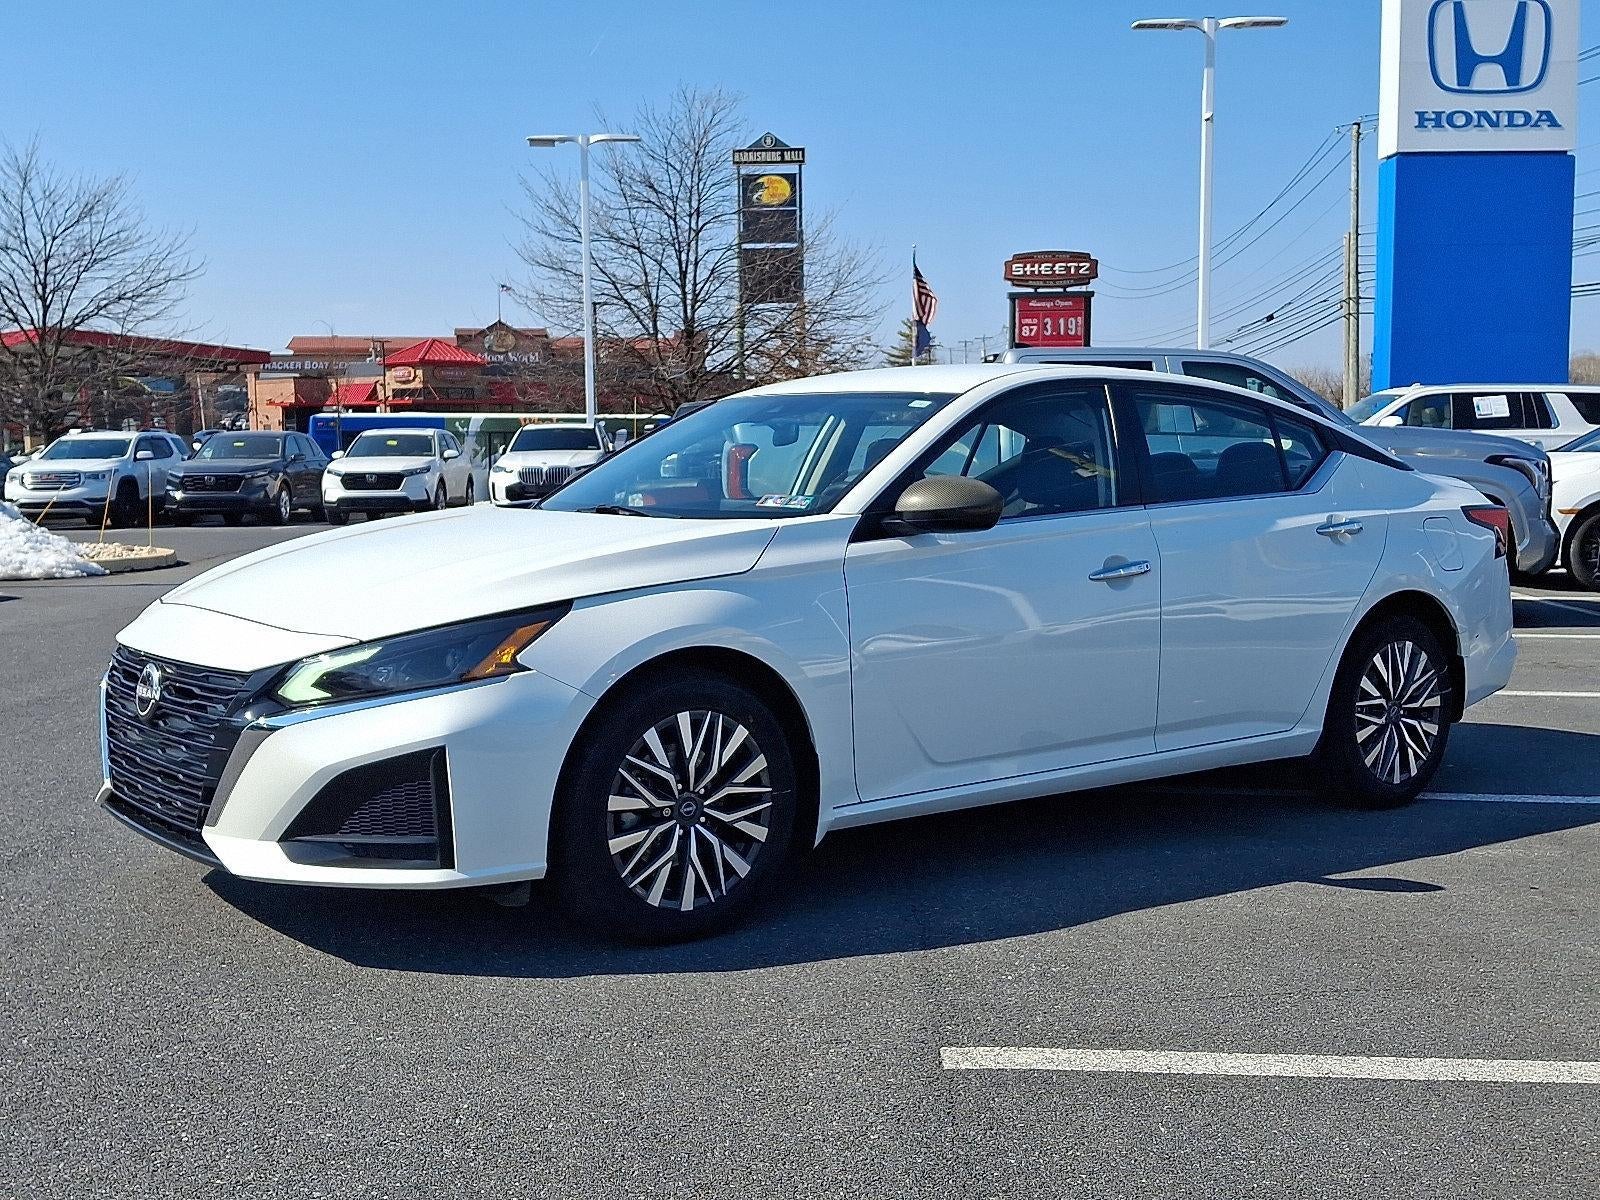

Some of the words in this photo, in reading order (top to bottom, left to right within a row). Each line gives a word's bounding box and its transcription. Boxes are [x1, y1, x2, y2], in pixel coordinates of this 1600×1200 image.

[1415, 110, 1562, 129] HONDA
[734, 151, 782, 162] HARRISBURG
[784, 150, 804, 161] MALL
[1011, 262, 1091, 275] SHEETZ
[1029, 300, 1054, 308] Always
[1055, 299, 1072, 307] Open
[1021, 326, 1038, 337] 87
[304, 360, 330, 370] BOAT
